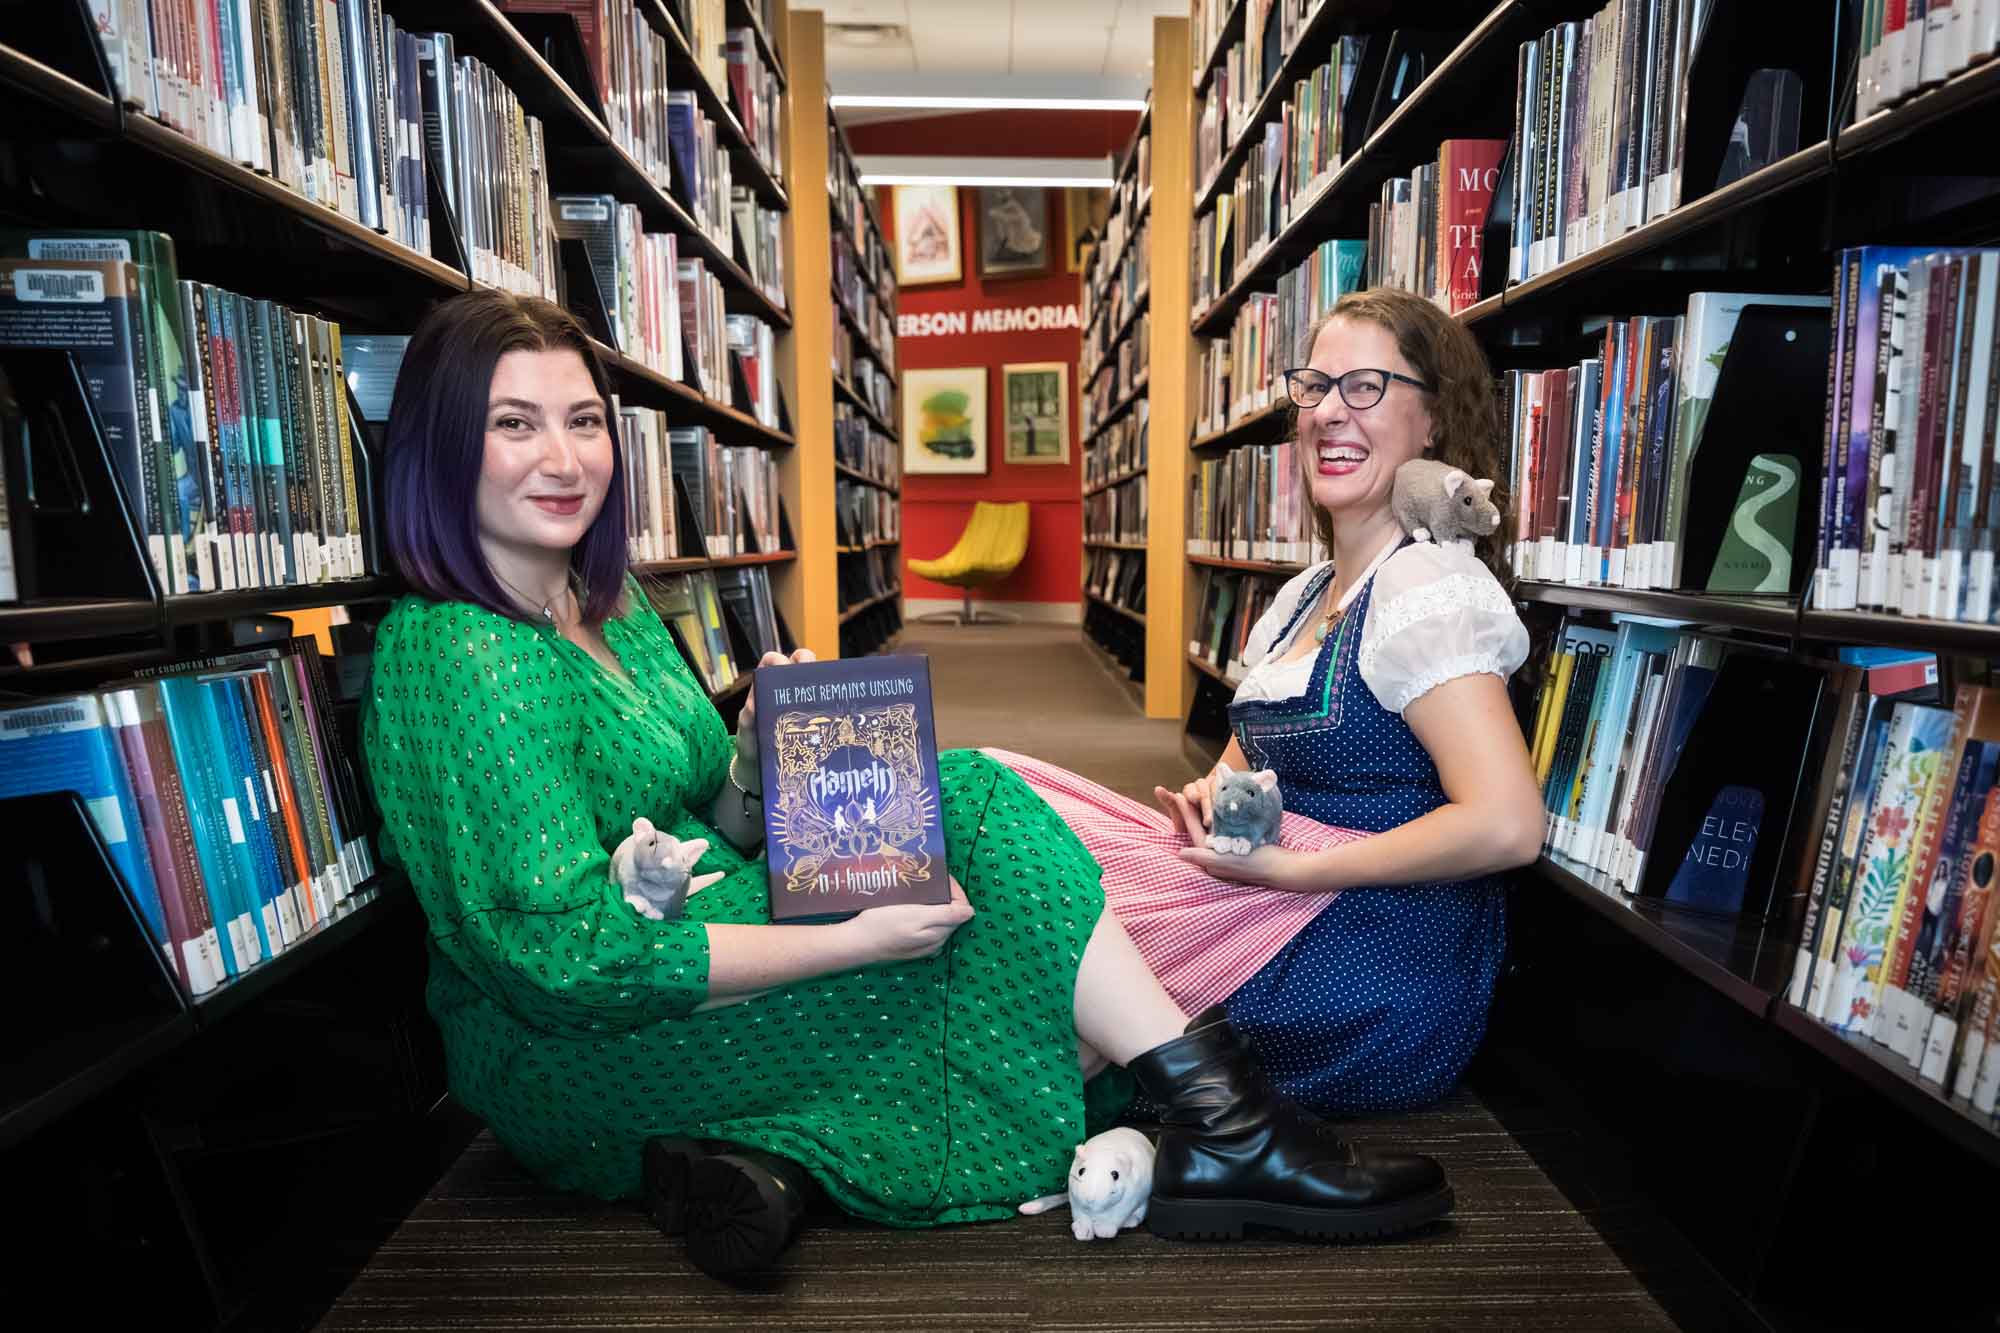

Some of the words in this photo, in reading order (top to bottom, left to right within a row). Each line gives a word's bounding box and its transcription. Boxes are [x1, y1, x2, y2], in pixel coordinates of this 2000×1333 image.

[1539, 81, 1549, 152] PERSONAL
[1551, 75, 1560, 147] PERSONAL
[1535, 162, 1544, 234] ASSISTANT
[1546, 158, 1556, 230] ASSISTANT
[1830, 264, 1841, 328] AMONG
[1846, 262, 1858, 326] AMONG
[1879, 292, 1894, 332] STAR
[1825, 351, 1836, 394] WILD
[1842, 350, 1854, 393] WILD
[1876, 336, 1891, 374] TREK
[1589, 408, 1601, 458] BELOW
[1616, 435, 1625, 475] NEWS
[1820, 398, 1833, 466] CYBERS
[1837, 397, 1851, 466] CYBERS
[1588, 461, 1596, 485] THE
[1584, 486, 1594, 522] FOLD
[774, 688, 792, 705] THE
[794, 685, 817, 703] PAST
[820, 681, 866, 702] REMAINS
[870, 678, 914, 697] UNSUNG
[171, 773, 193, 841] ELIZABETH
[810, 760, 893, 805] Hameln
[1824, 793, 1844, 836] THE
[1914, 749, 1954, 885] BRIGHTEST
[1810, 837, 1833, 895] GUNS
[1862, 829, 1876, 859] Plot
[1898, 893, 1918, 941] SUN
